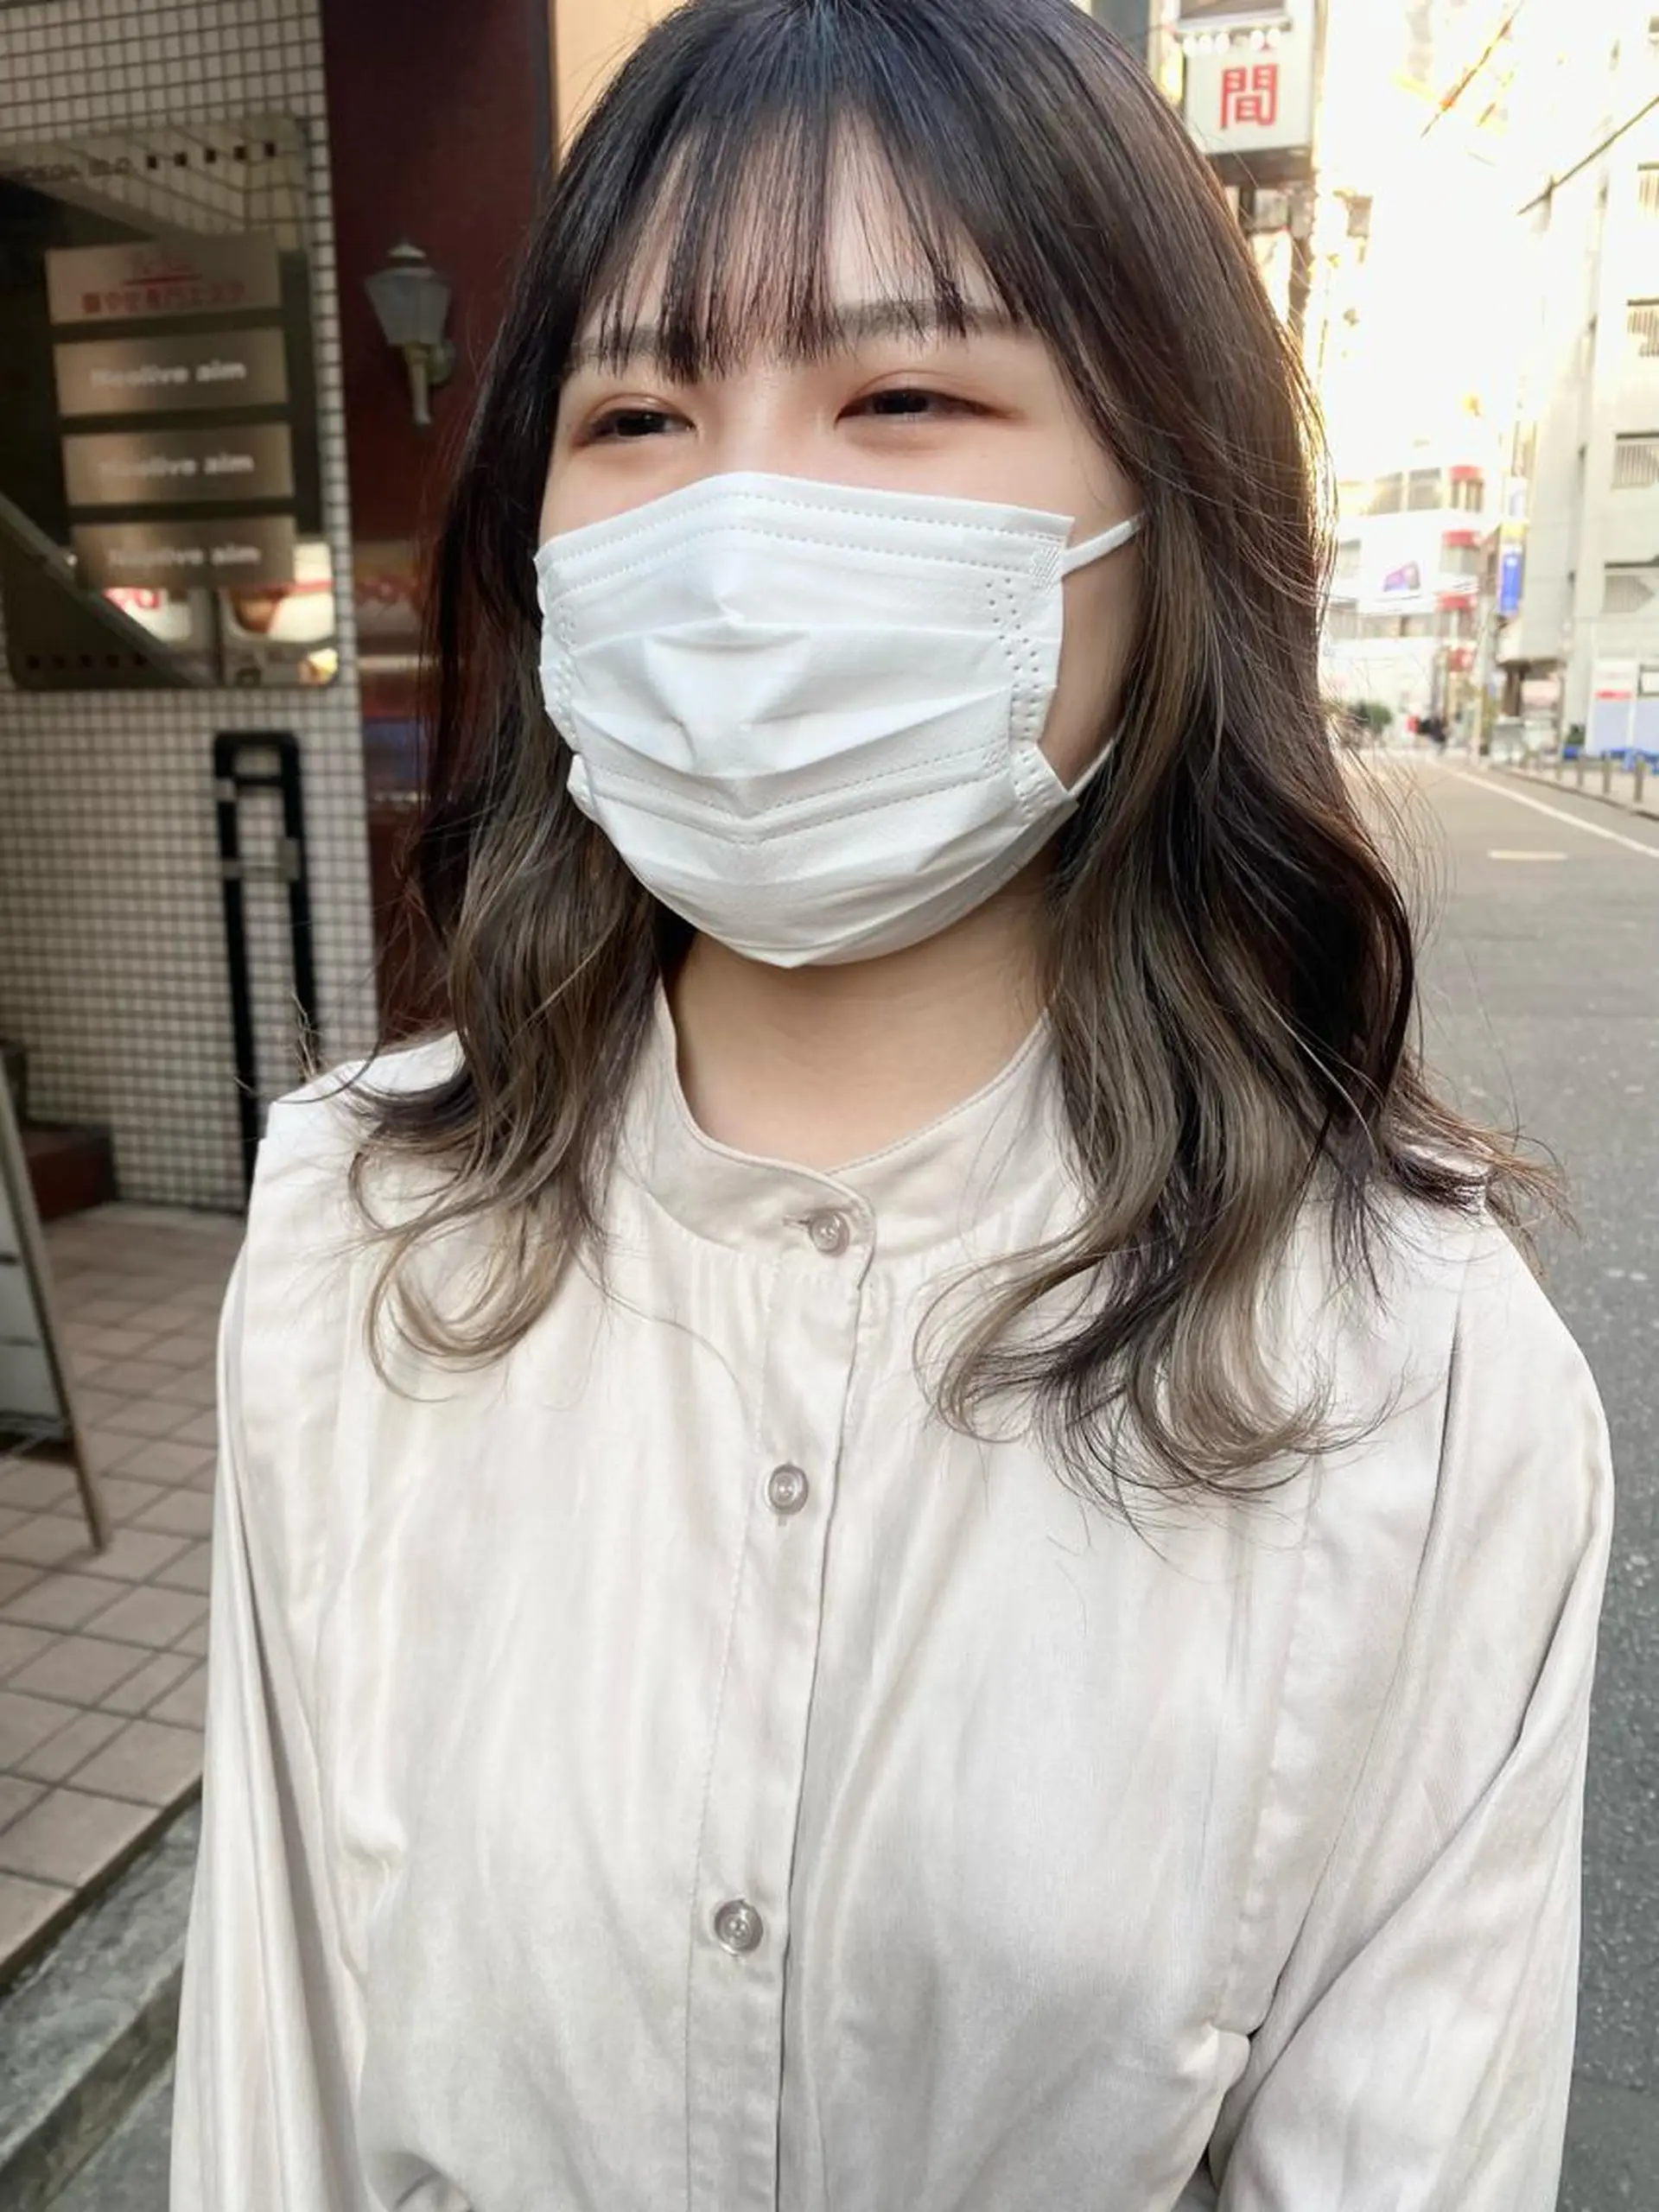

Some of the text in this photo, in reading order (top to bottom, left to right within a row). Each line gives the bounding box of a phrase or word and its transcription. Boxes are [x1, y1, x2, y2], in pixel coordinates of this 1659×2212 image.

[1220, 63, 1278, 130] 間
[195, 359, 246, 382] aim
[204, 452, 254, 475] aim
